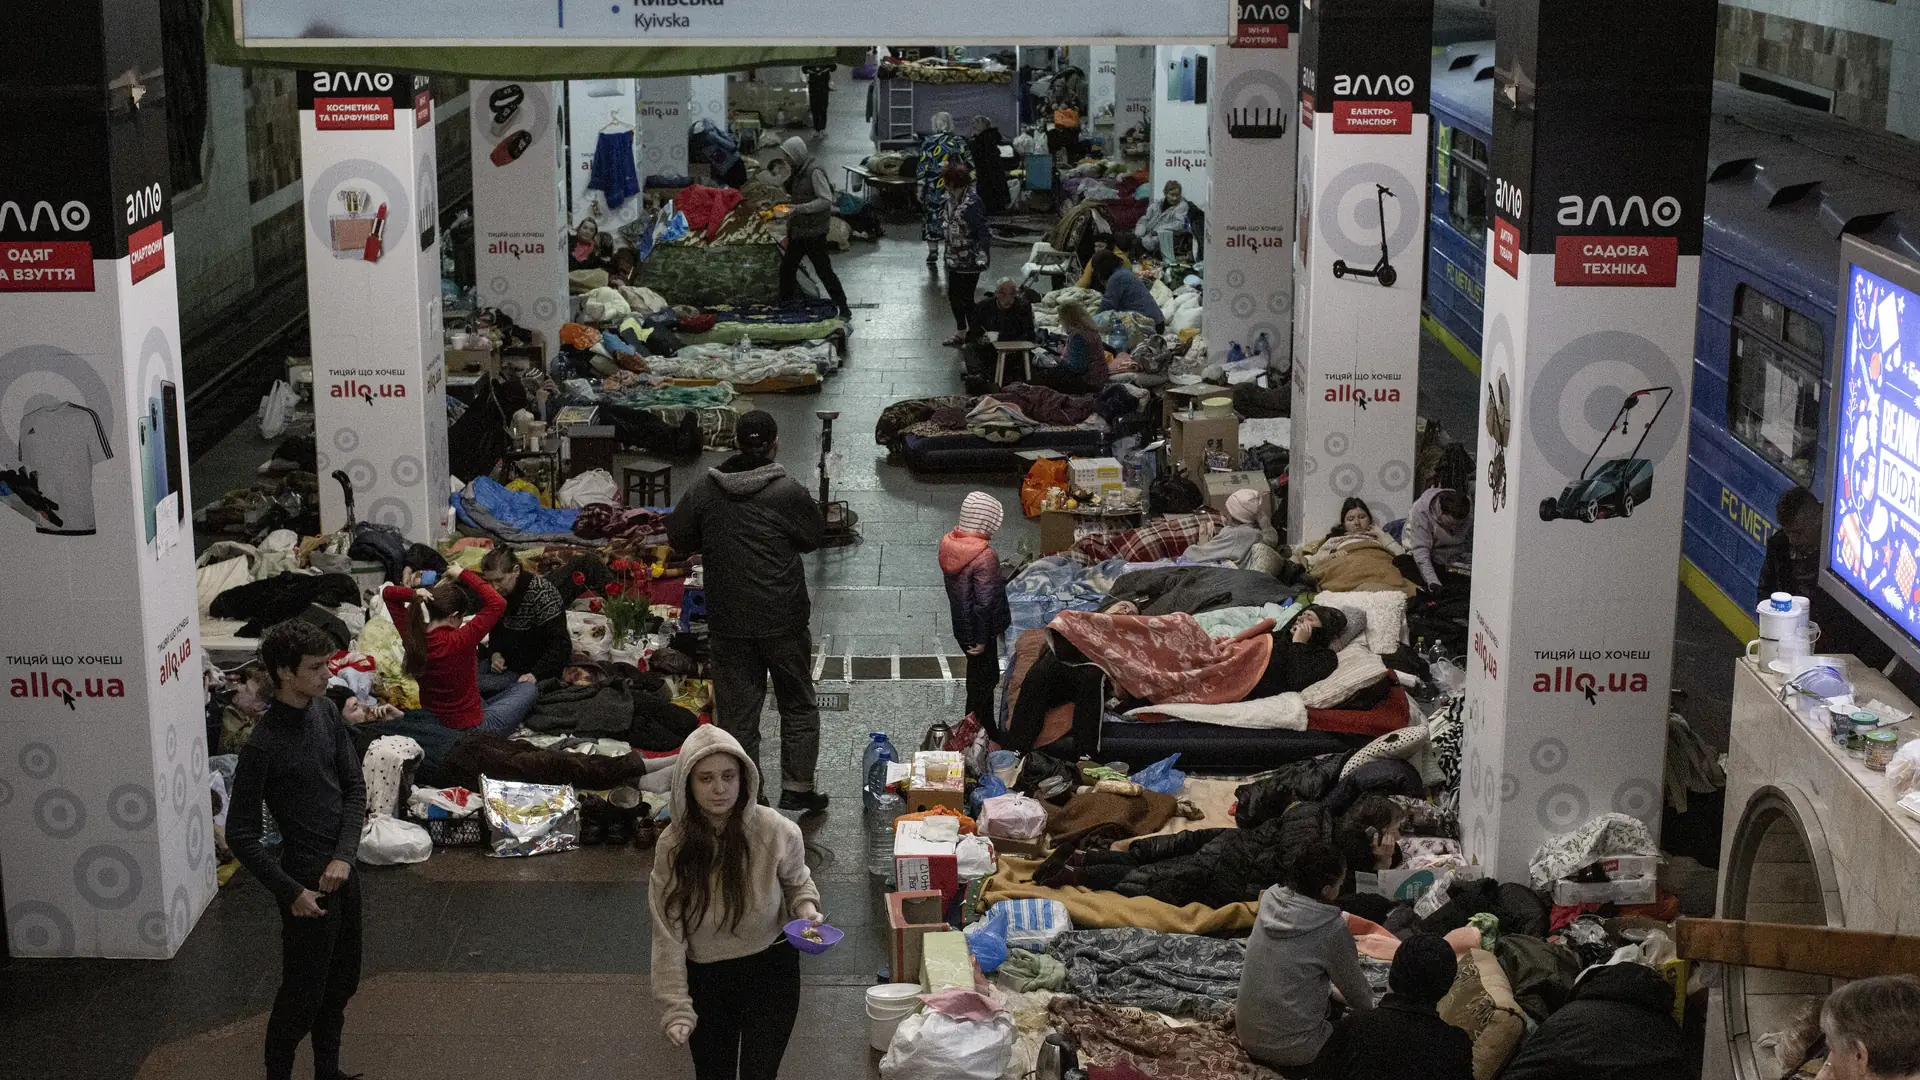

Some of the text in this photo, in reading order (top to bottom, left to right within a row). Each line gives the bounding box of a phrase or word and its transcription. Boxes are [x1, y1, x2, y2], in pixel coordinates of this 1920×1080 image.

[634, 12, 690, 32] Kyivska
[326, 104, 380, 112] КОСМЕТИКА
[1350, 108, 1393, 116] ЕЛЕКТРО-
[331, 114, 389, 122] ПАРФУМЕРІЯ
[1346, 118, 1398, 126] ТРАНСПОРТ
[0, 200, 91, 232] лло
[488, 240, 545, 254] allo.ua
[1226, 234, 1283, 248] allo.ua
[7, 248, 54, 263] ОДЯГ
[131, 239, 163, 265] СМАРТФОНИ
[1582, 244, 1649, 259] САДОВА
[13, 267, 76, 281] ВЗУТТЯ
[1582, 262, 1648, 275] ТЕХНІКА
[329, 368, 356, 377] ТИЦЯЙ
[358, 369, 373, 377] ЩО
[1325, 372, 1353, 381] ТИЦЯЙ
[1355, 373, 1370, 381] ЩО
[329, 380, 406, 398] allo.ua
[1324, 384, 1401, 402] allo.ua
[1881, 399, 1920, 468] ВЕЛИК
[1721, 486, 1778, 547] FC MET
[7, 654, 123, 666] ТИЦЯЙ ЩО ХОЧЕШ
[159, 637, 191, 686] allo.ua
[1534, 648, 1650, 661] ТИЦЯЙ ЩО ХОЧЕШ
[10, 671, 125, 698] allo.ua
[1532, 666, 1648, 693] allo.ua
